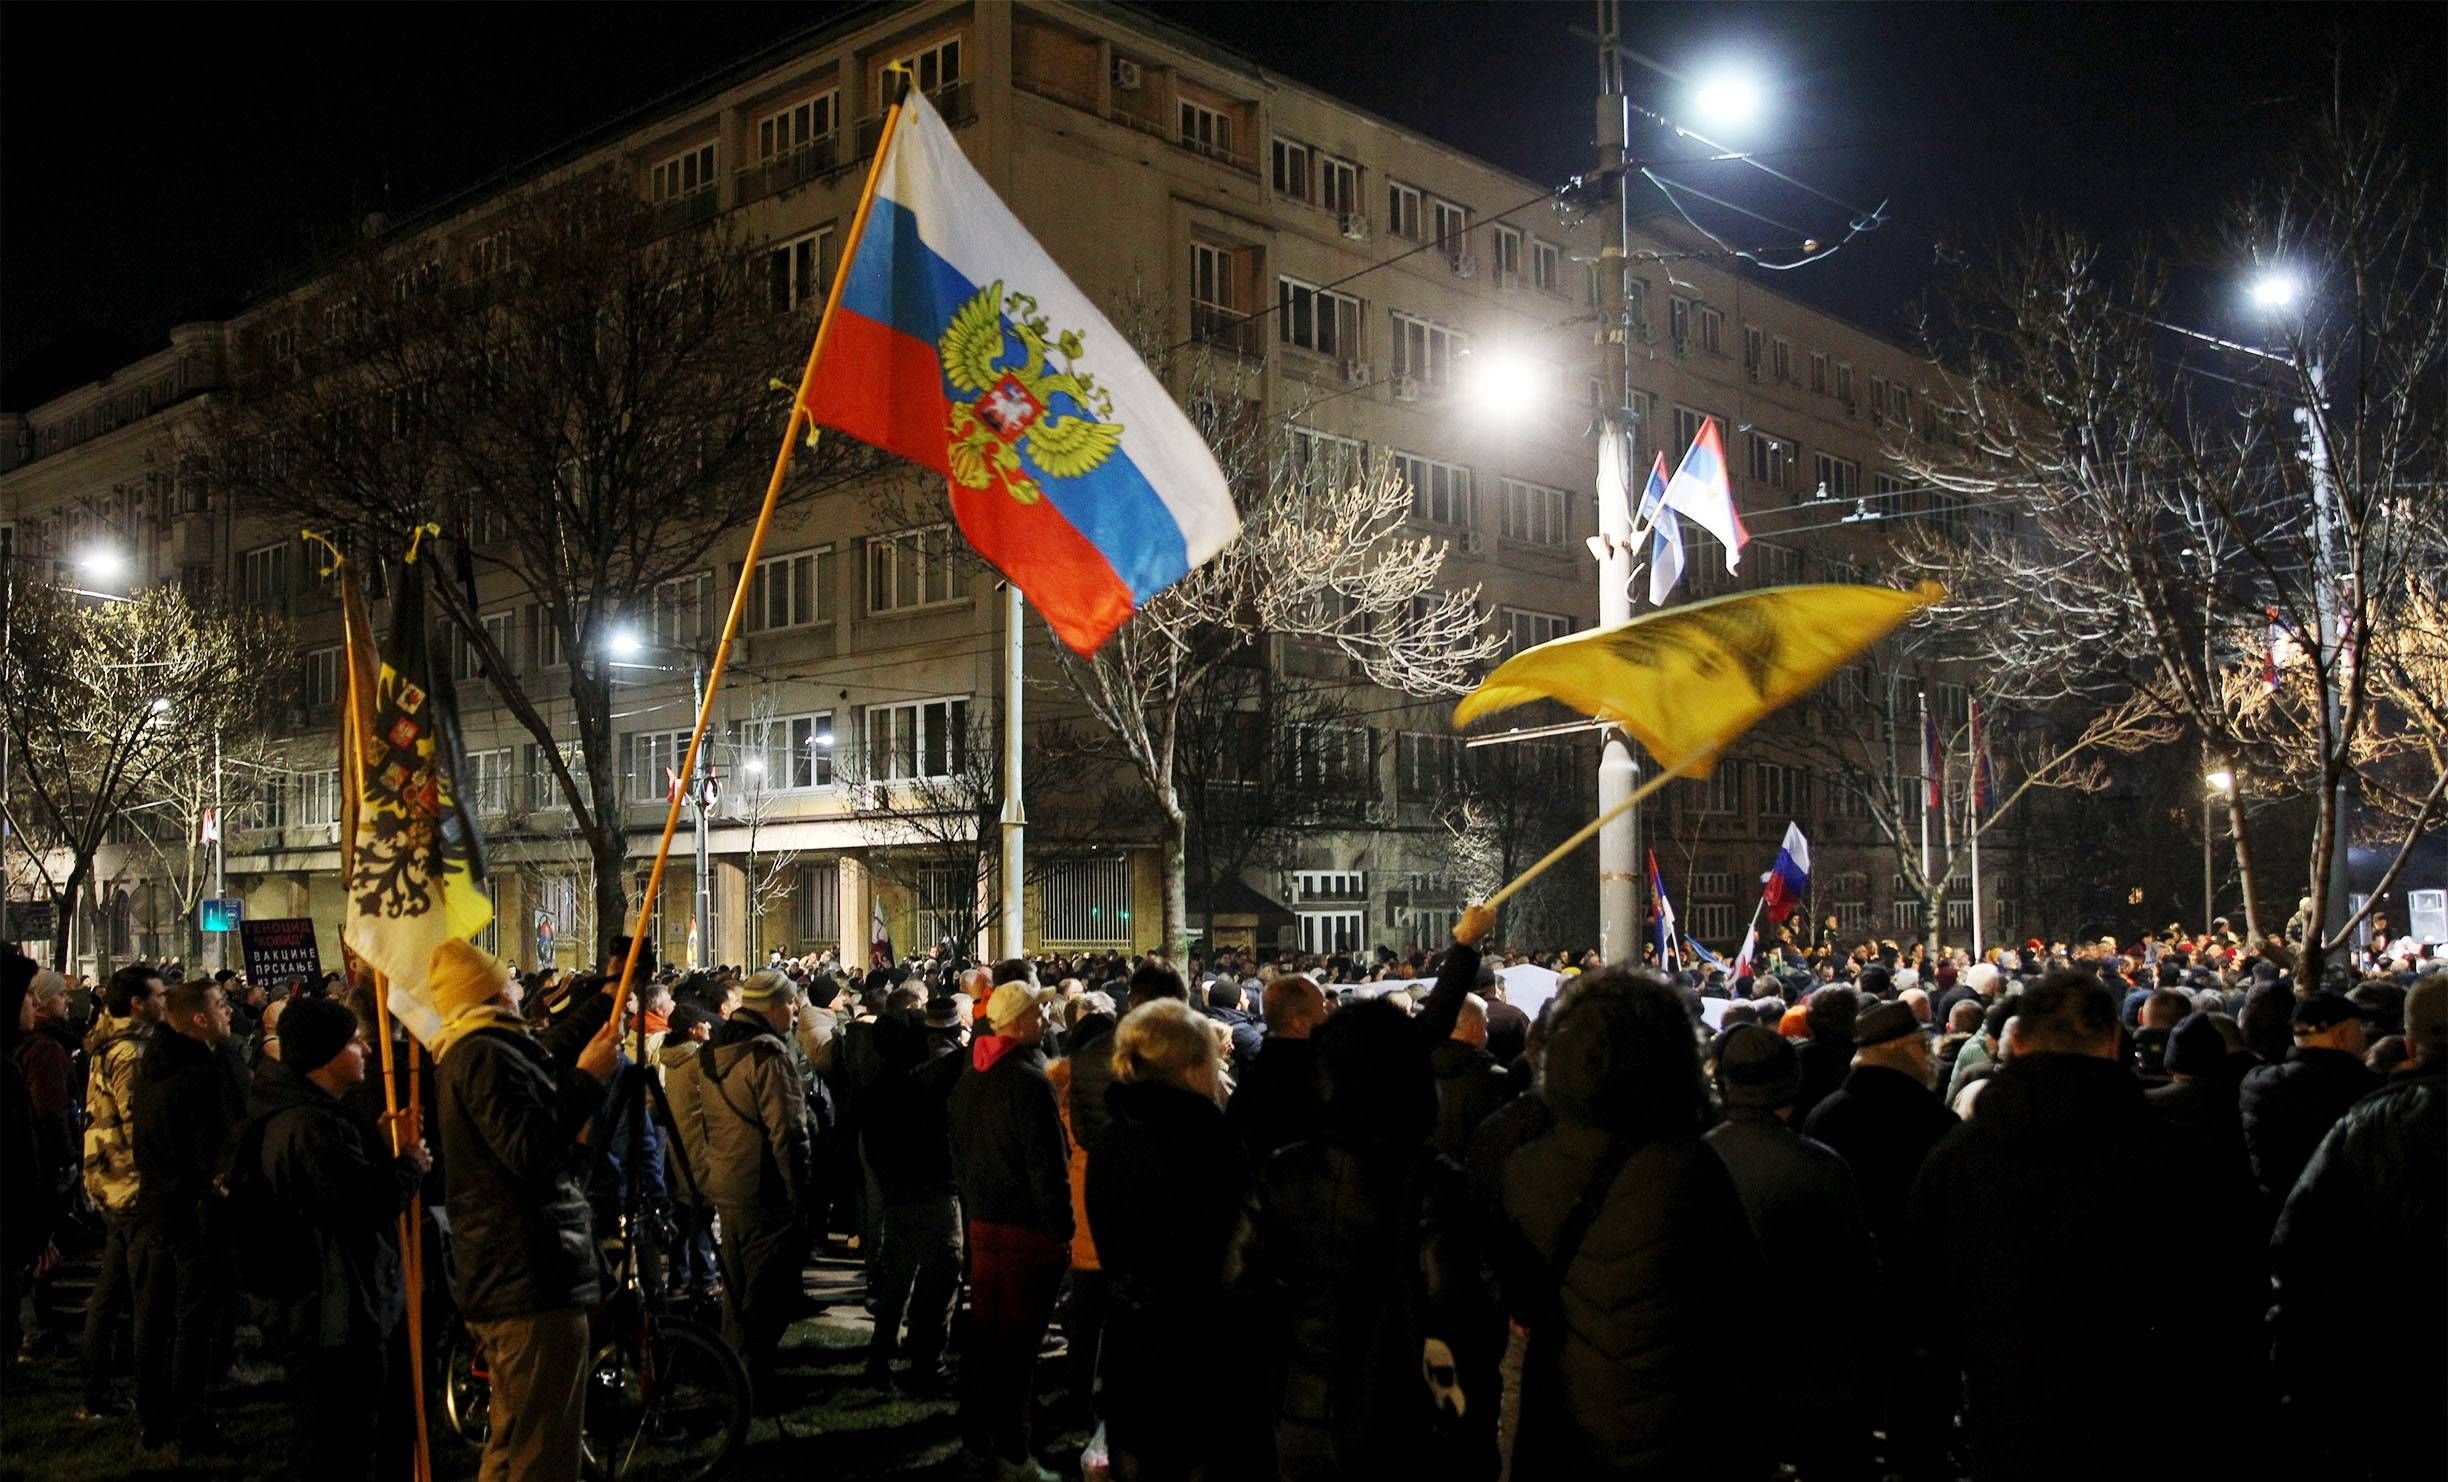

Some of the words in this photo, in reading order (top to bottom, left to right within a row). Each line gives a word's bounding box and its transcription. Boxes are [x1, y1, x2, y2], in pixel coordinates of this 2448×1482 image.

[245, 921, 311, 935] ГЕНОЦИД
[253, 948, 316, 961] ВАКЦИНЕ
[255, 961, 314, 975] ПРСКАЊЕ
